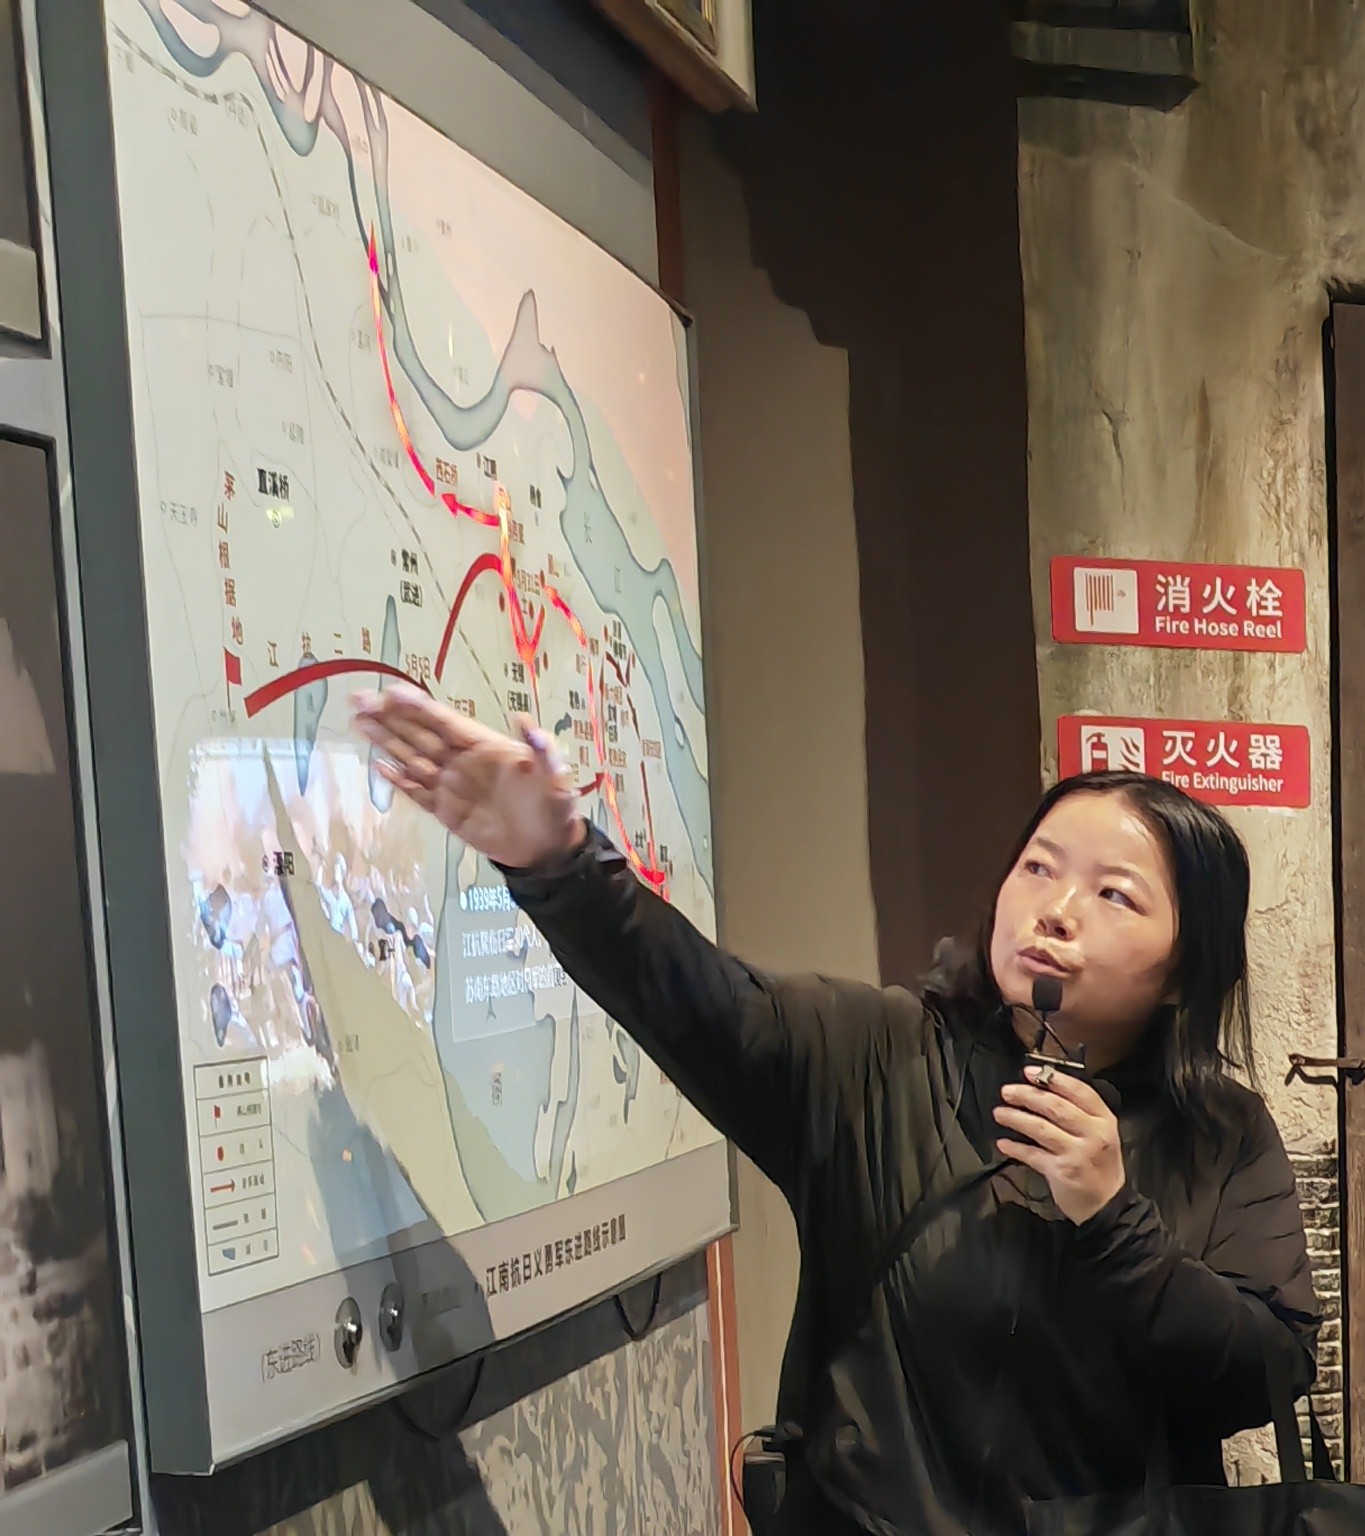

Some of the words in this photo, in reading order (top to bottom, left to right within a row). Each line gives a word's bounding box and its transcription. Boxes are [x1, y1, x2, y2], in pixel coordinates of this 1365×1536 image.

[1155, 574, 1284, 617] 消火栓
[1155, 615, 1191, 635] Fire
[1194, 618, 1239, 637] Hose
[1243, 621, 1283, 639] Reel
[1162, 730, 1283, 771] 灭火器
[1193, 772, 1284, 795] Extinguisher
[485, 1213, 626, 1297] 江南抗日义勇军东进路线示意图
